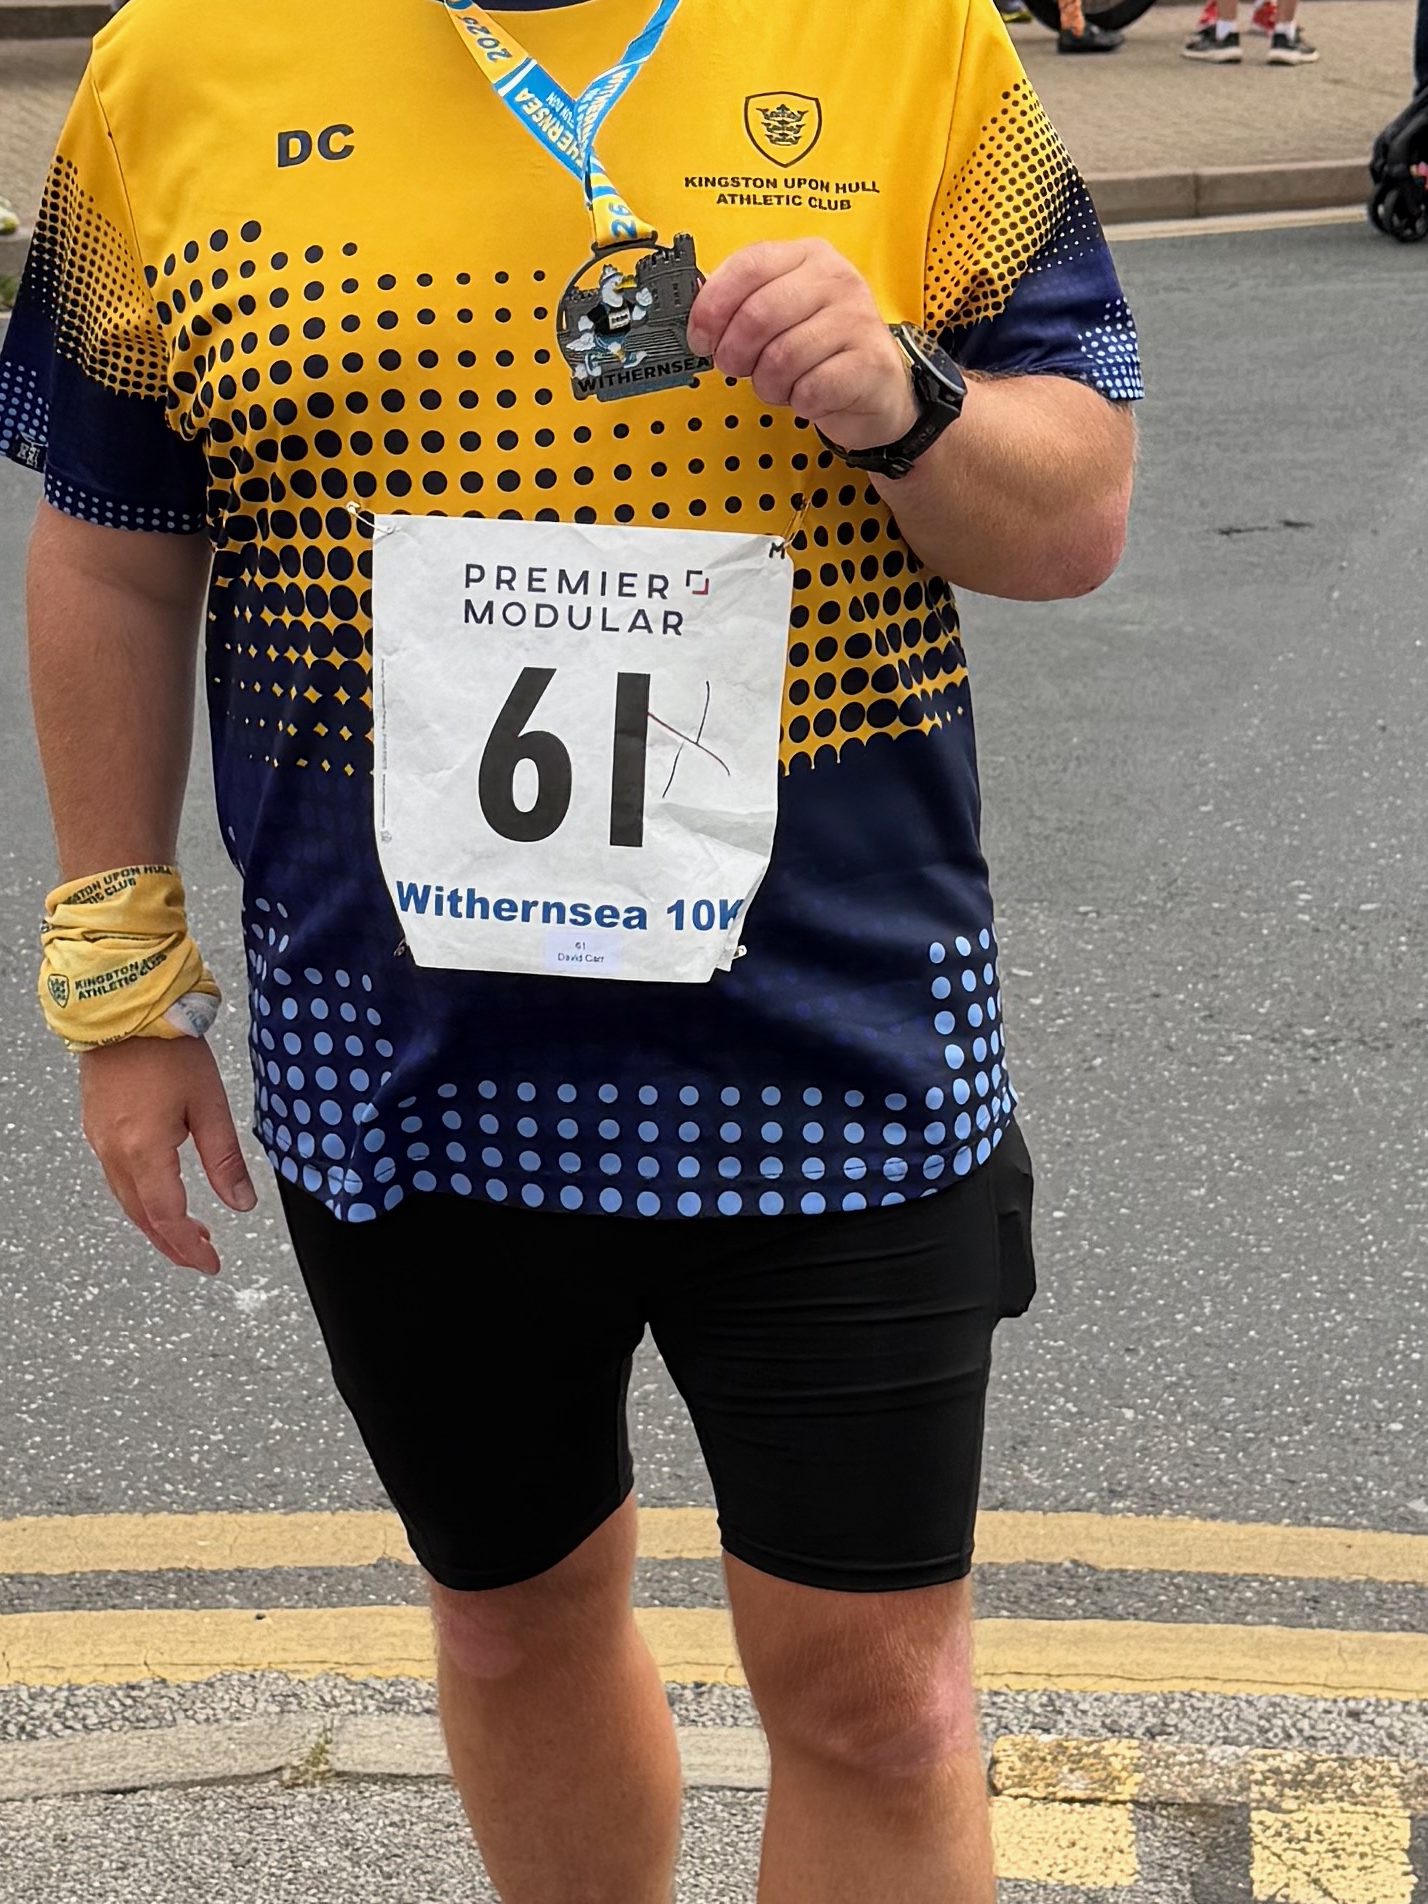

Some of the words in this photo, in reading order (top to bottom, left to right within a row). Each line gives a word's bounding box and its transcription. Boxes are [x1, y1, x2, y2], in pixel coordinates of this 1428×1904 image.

[277, 123, 355, 168] DC
[684, 176, 777, 189] KINGSTON
[784, 177, 830, 193] UPON
[835, 180, 880, 194] HULL
[716, 193, 802, 207] ATHLETIC
[808, 196, 851, 211] CLUB
[577, 355, 710, 393] WITHERNSEA
[464, 563, 670, 600] PREMIER
[464, 598, 684, 636] MODULAR
[478, 666, 651, 848] 61
[103, 866, 141, 886] UPON
[104, 877, 137, 898] CLUB
[396, 880, 648, 931] Withernsea
[667, 898, 746, 932] 10K
[74, 961, 140, 991] KINGSTON
[77, 972, 139, 1002] ATHLETIC
